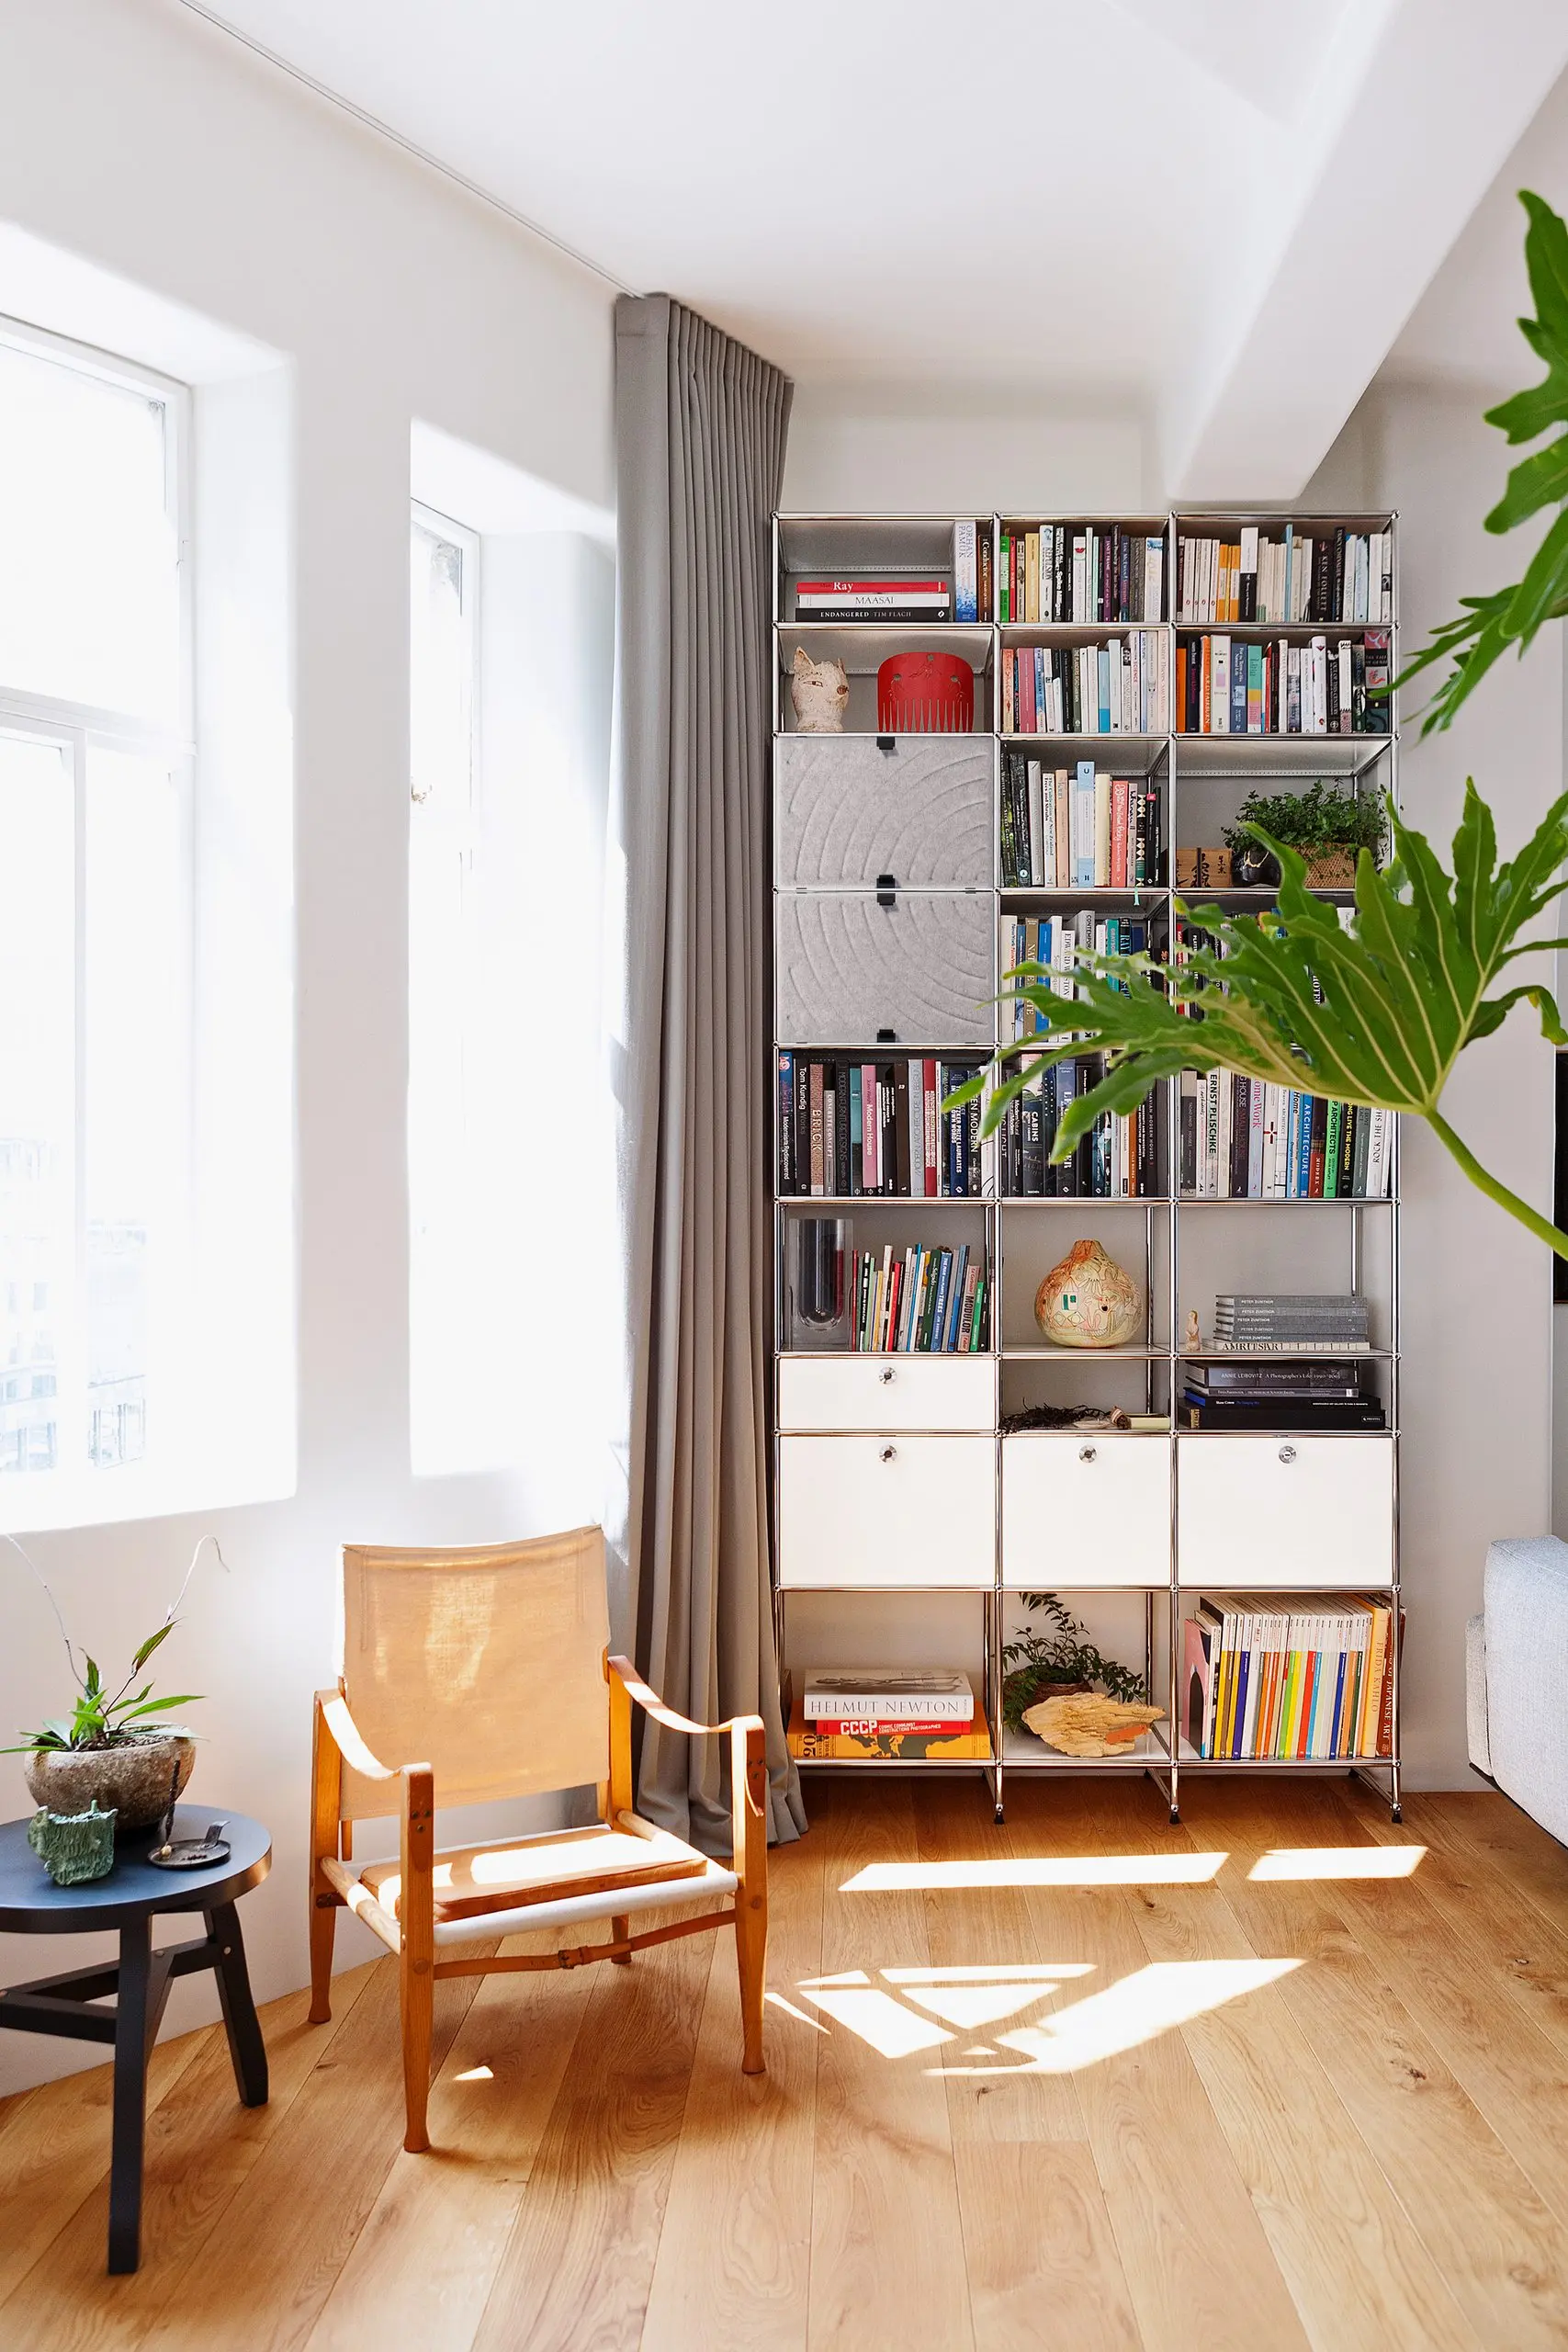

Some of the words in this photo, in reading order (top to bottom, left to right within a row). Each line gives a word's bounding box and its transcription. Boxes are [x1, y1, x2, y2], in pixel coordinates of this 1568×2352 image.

[982, 541, 990, 577] Conductor
[833, 582, 853, 593] Ray
[855, 596, 894, 605] MAASAI
[798, 1084, 807, 1110] Kundig
[838, 1071, 846, 1099] MODERN
[1209, 1073, 1218, 1104] ERNST
[1238, 1081, 1247, 1107] HOUSE
[839, 1100, 847, 1132] FURNITURE
[1252, 1102, 1261, 1128] Work
[1292, 1091, 1301, 1114] Home
[799, 1112, 807, 1135] Works
[812, 1109, 821, 1150] BRICK
[970, 1113, 978, 1152] MODERN
[1209, 1107, 1217, 1154] PLISCHKE
[1328, 1106, 1337, 1155] ARCHITECTS
[839, 1133, 847, 1160] DESIGNS
[1301, 1103, 1311, 1175] ARCHITECTURE
[1372, 1142, 1381, 1163] ROCK
[782, 1146, 791, 1180] Rediscovered
[961, 1295, 975, 1334] MODULOR
[1223, 1342, 1279, 1351] AMRITSAR
[1374, 1642, 1383, 1672] FRIDA
[810, 1701, 878, 1713] HELMUT
[886, 1701, 959, 1713] NEWTON
[1371, 1677, 1382, 1712] KAHLO
[1383, 1680, 1393, 1720] JAPANESE
[840, 1720, 878, 1736] CCCP
[1382, 1723, 1392, 1738] ART
[803, 1735, 816, 1757] 20
